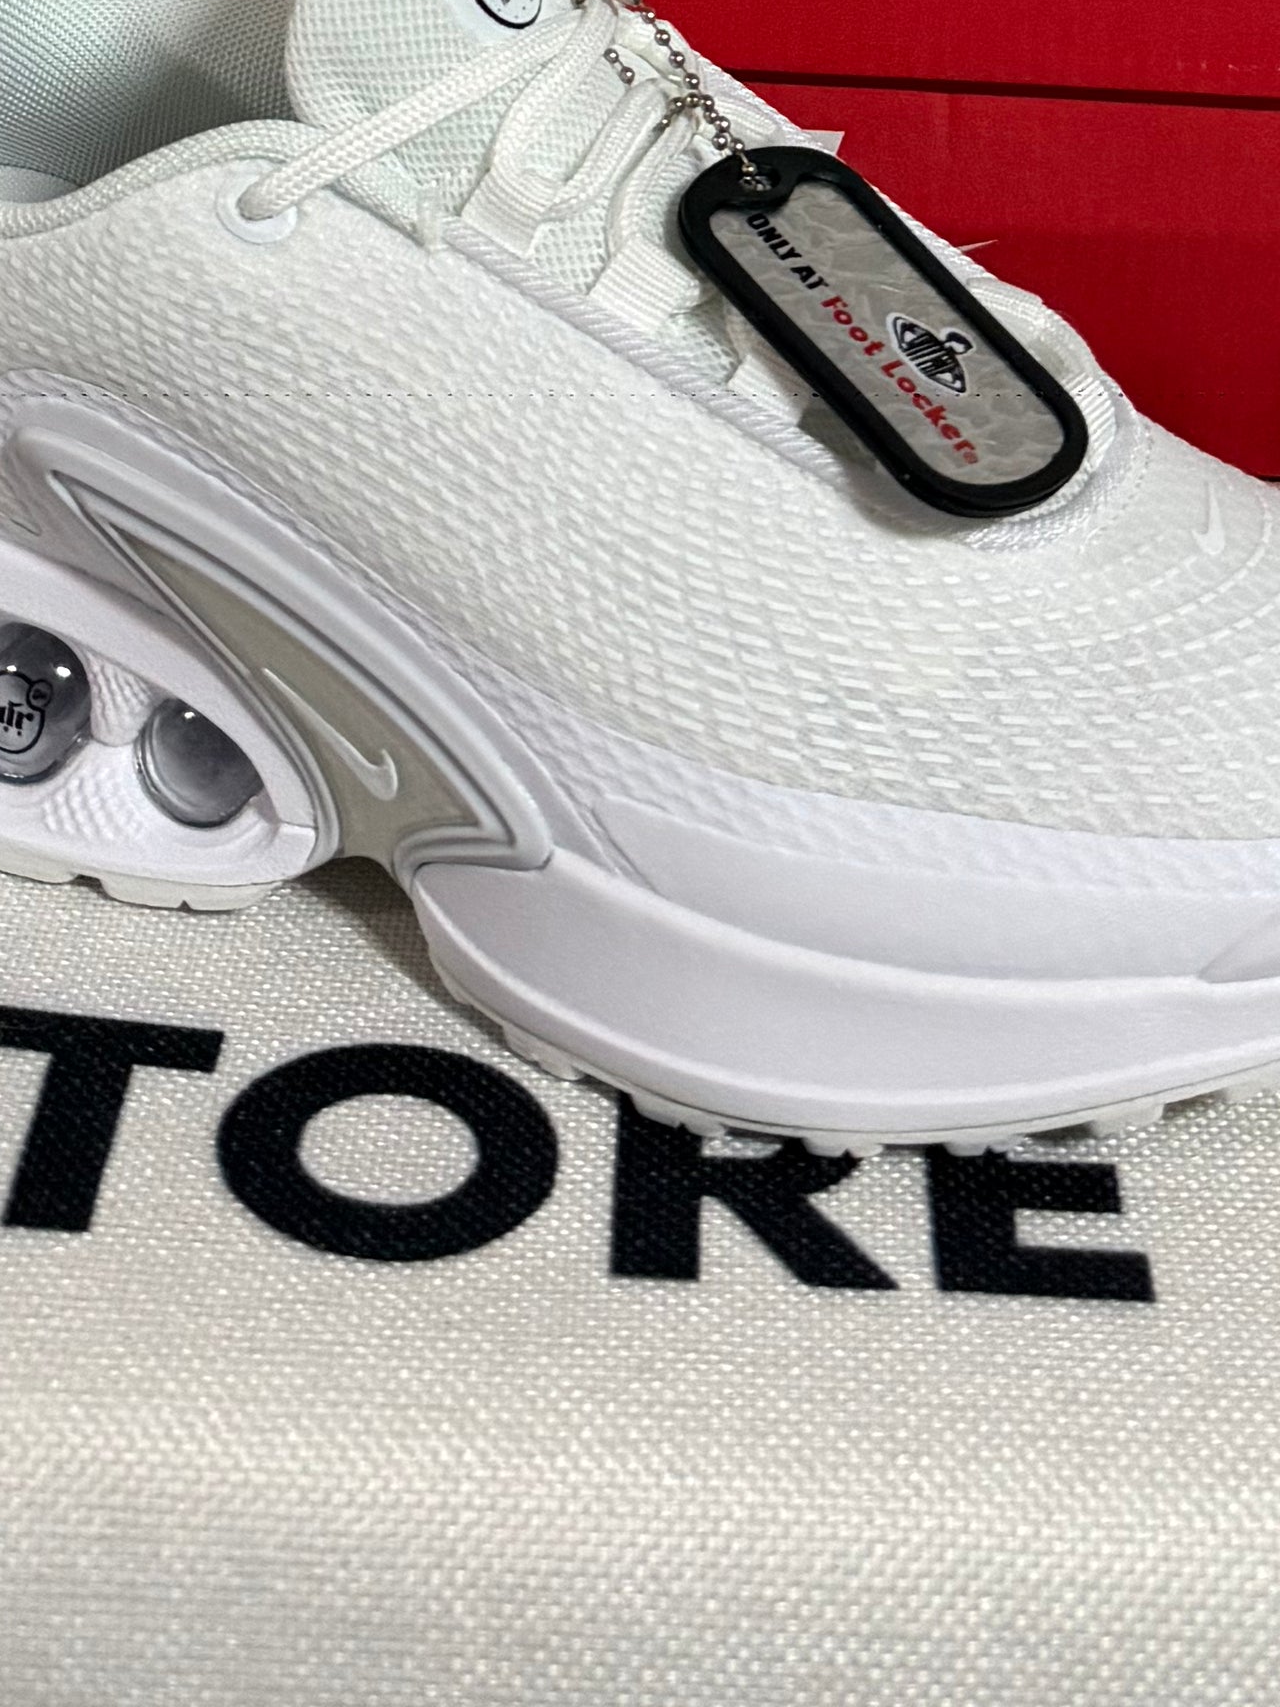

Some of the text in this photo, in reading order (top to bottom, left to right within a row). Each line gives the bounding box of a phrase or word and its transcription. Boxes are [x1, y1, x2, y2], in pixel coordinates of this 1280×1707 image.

[745, 212, 803, 262] ONLY
[789, 264, 830, 290] AT
[820, 295, 886, 357] Foot
